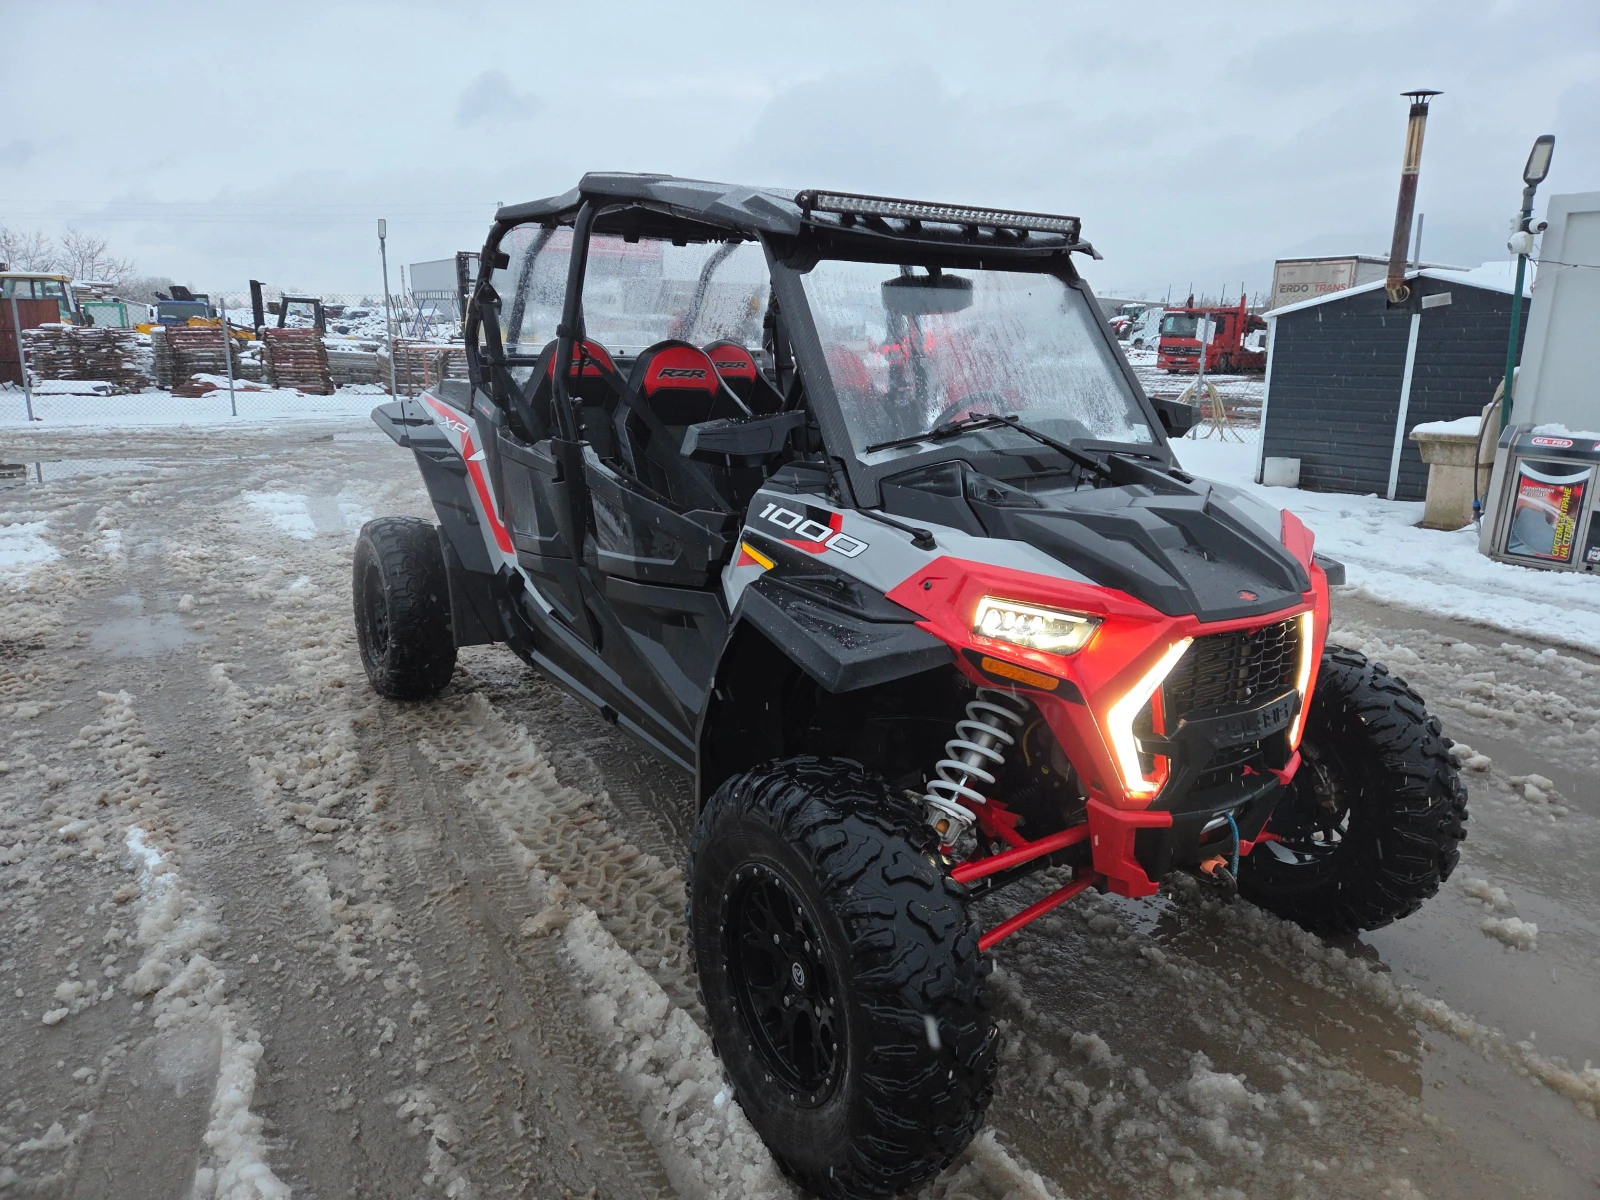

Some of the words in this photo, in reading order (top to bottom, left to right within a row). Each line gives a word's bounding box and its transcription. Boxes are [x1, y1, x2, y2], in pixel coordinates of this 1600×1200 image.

[1314, 283, 1347, 292] TRANS
[715, 361, 748, 369] RZR
[657, 368, 706, 380] RZR
[440, 416, 469, 433] XP
[1560, 486, 1572, 513] ПРАНЕ
[1558, 511, 1568, 523] ЗА
[759, 503, 870, 558] 1000
[1563, 517, 1575, 546] СТЕЛКИ
[1552, 522, 1565, 556] СИСТЕМА
[1559, 546, 1570, 558] НА
